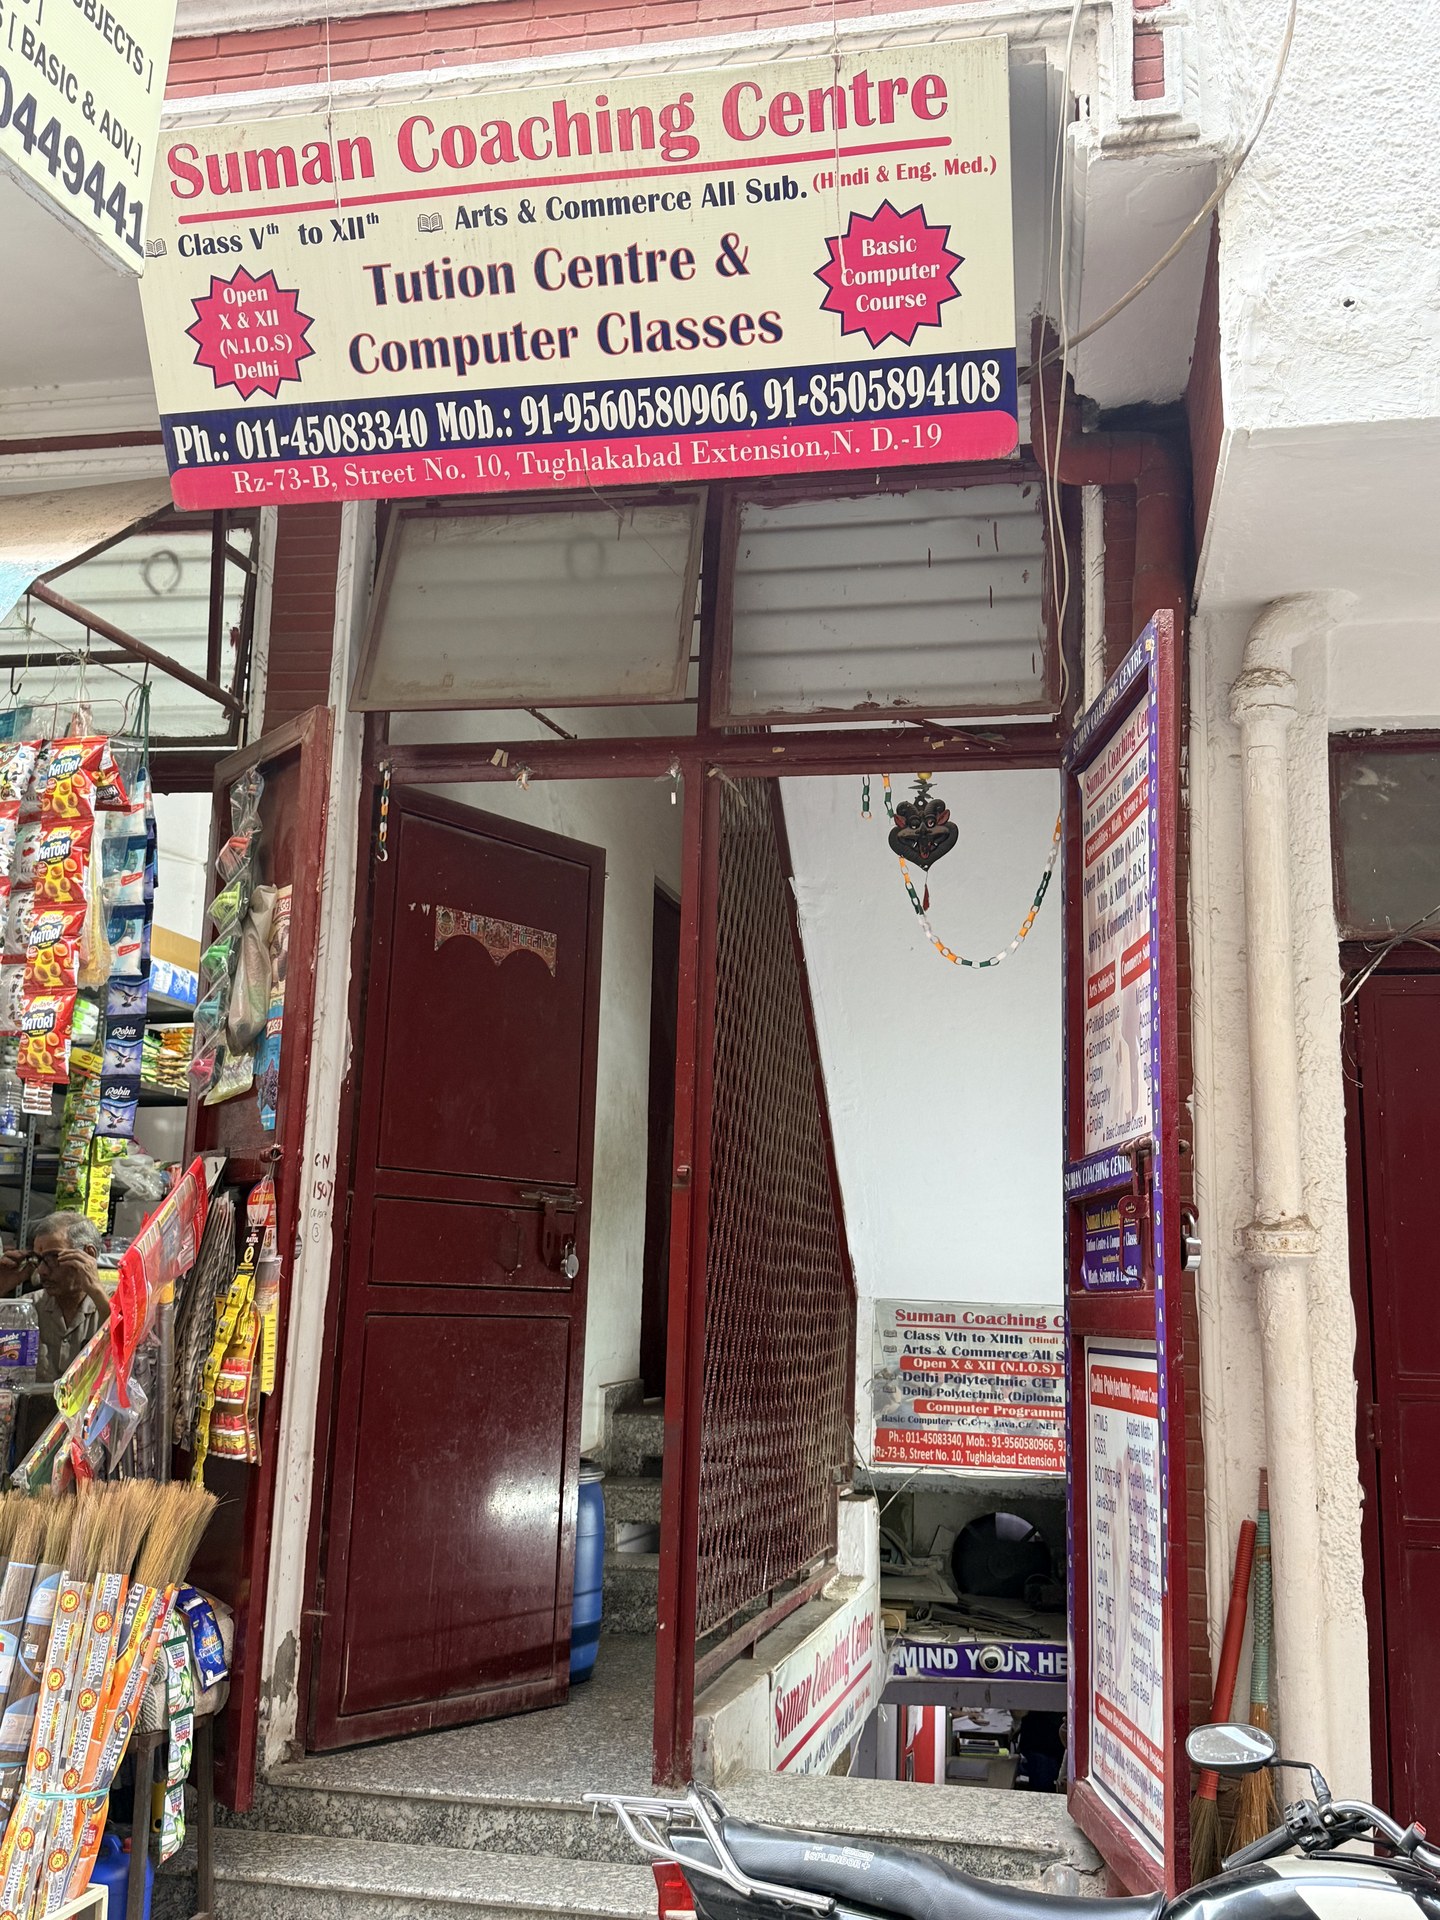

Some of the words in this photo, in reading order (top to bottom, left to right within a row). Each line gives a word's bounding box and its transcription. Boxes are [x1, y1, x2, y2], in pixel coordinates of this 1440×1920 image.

[73, 0, 144, 76] BJECTS
[21, 24, 78, 105] BASIC
[82, 90, 95, 126] &
[166, 134, 376, 200] Suman
[397, 91, 701, 174] Coaching
[722, 68, 950, 142] Centre
[454, 203, 508, 231] Arts
[517, 199, 536, 224] &
[545, 188, 692, 220] Commerce
[700, 182, 736, 209] All
[745, 175, 808, 203] Sub.
[812, 169, 869, 193] (Hindi
[876, 167, 890, 182] &
[896, 163, 937, 183] Eng.
[943, 154, 997, 177] Med.)
[177, 233, 243, 259] Class
[298, 222, 323, 247] to
[330, 212, 380, 243] XIIth
[861, 235, 917, 257] Basic
[362, 255, 516, 306] Tution
[534, 238, 696, 293] Centre
[715, 232, 751, 277] &
[840, 262, 940, 288] Computer
[223, 287, 268, 308] Open
[855, 292, 927, 313] Course
[218, 314, 232, 330] X
[236, 312, 250, 329] &
[254, 309, 279, 327] XII
[219, 334, 293, 360] (N.I.O.S)
[349, 320, 579, 377] Computer
[597, 309, 784, 357] Classes
[234, 360, 280, 381] Delhi
[172, 424, 229, 466] Ph.:
[235, 407, 429, 461] 011-45083340
[436, 399, 512, 443] Mob.:
[231, 465, 338, 494] Rz-73-B,
[343, 461, 415, 486] Street
[423, 456, 466, 482] No.
[475, 453, 511, 481] 10,
[517, 438, 683, 482] Tughlakabad
[1073, 719, 1091, 755] SUMAN
[1119, 643, 1143, 690] CENTRE
[48, 756, 81, 778] KATORI
[1086, 764, 1107, 799] Suman
[1107, 721, 1136, 775] Coaching
[35, 840, 70, 861] KATORI
[29, 925, 63, 945] KATORI
[112, 1025, 137, 1040] Robin
[105, 1086, 131, 1100] Robin
[1064, 1170, 1081, 1192] SUMAN
[1082, 1158, 1109, 1187] COACHING
[895, 1308, 956, 1323] Suman
[962, 1311, 1047, 1330] Coaching
[903, 1330, 940, 1342] Class
[944, 1331, 967, 1342] Vth
[971, 1333, 986, 1343] to
[990, 1333, 1023, 1345] XIIth
[1028, 1336, 1058, 1345] (Hindi
[902, 1344, 932, 1355] Arts
[936, 1346, 947, 1356] &
[951, 1346, 1028, 1360] Commerce
[1032, 1350, 1050, 1361] All
[913, 1358, 947, 1370] Open
[950, 1359, 960, 1369] X
[964, 1360, 974, 1370] &
[978, 1361, 996, 1371] XII
[999, 1361, 1056, 1375] (N.I.O.S)
[902, 1371, 939, 1384] Delhi
[944, 1373, 1027, 1388] Polytechnic
[1031, 1377, 1059, 1388] CET
[902, 1386, 933, 1397] Delhi
[1008, 1392, 1062, 1404] (Diploma
[926, 1402, 989, 1415] Computer
[881, 1414, 906, 1423] Basic
[907, 1415, 953, 1427] Computer,
[888, 1430, 904, 1443] Ph.:
[905, 1431, 964, 1447] 011-45083340,
[966, 1434, 990, 1447] Mob.:
[991, 1436, 1056, 1452] 91-9560580966,
[909, 1447, 935, 1460] Street
[935, 1448, 950, 1461] No.
[951, 1449, 964, 1462] 10,
[965, 1451, 1016, 1467] Tughlakabad
[1018, 1453, 1058, 1468] Extension
[900, 1646, 959, 1670] MIND
[964, 1648, 1030, 1673] YUR
[1038, 1652, 1067, 1674] HE
[774, 1674, 812, 1749] Suman
[812, 1629, 850, 1708] Coaching
[851, 1609, 874, 1666] Centre
